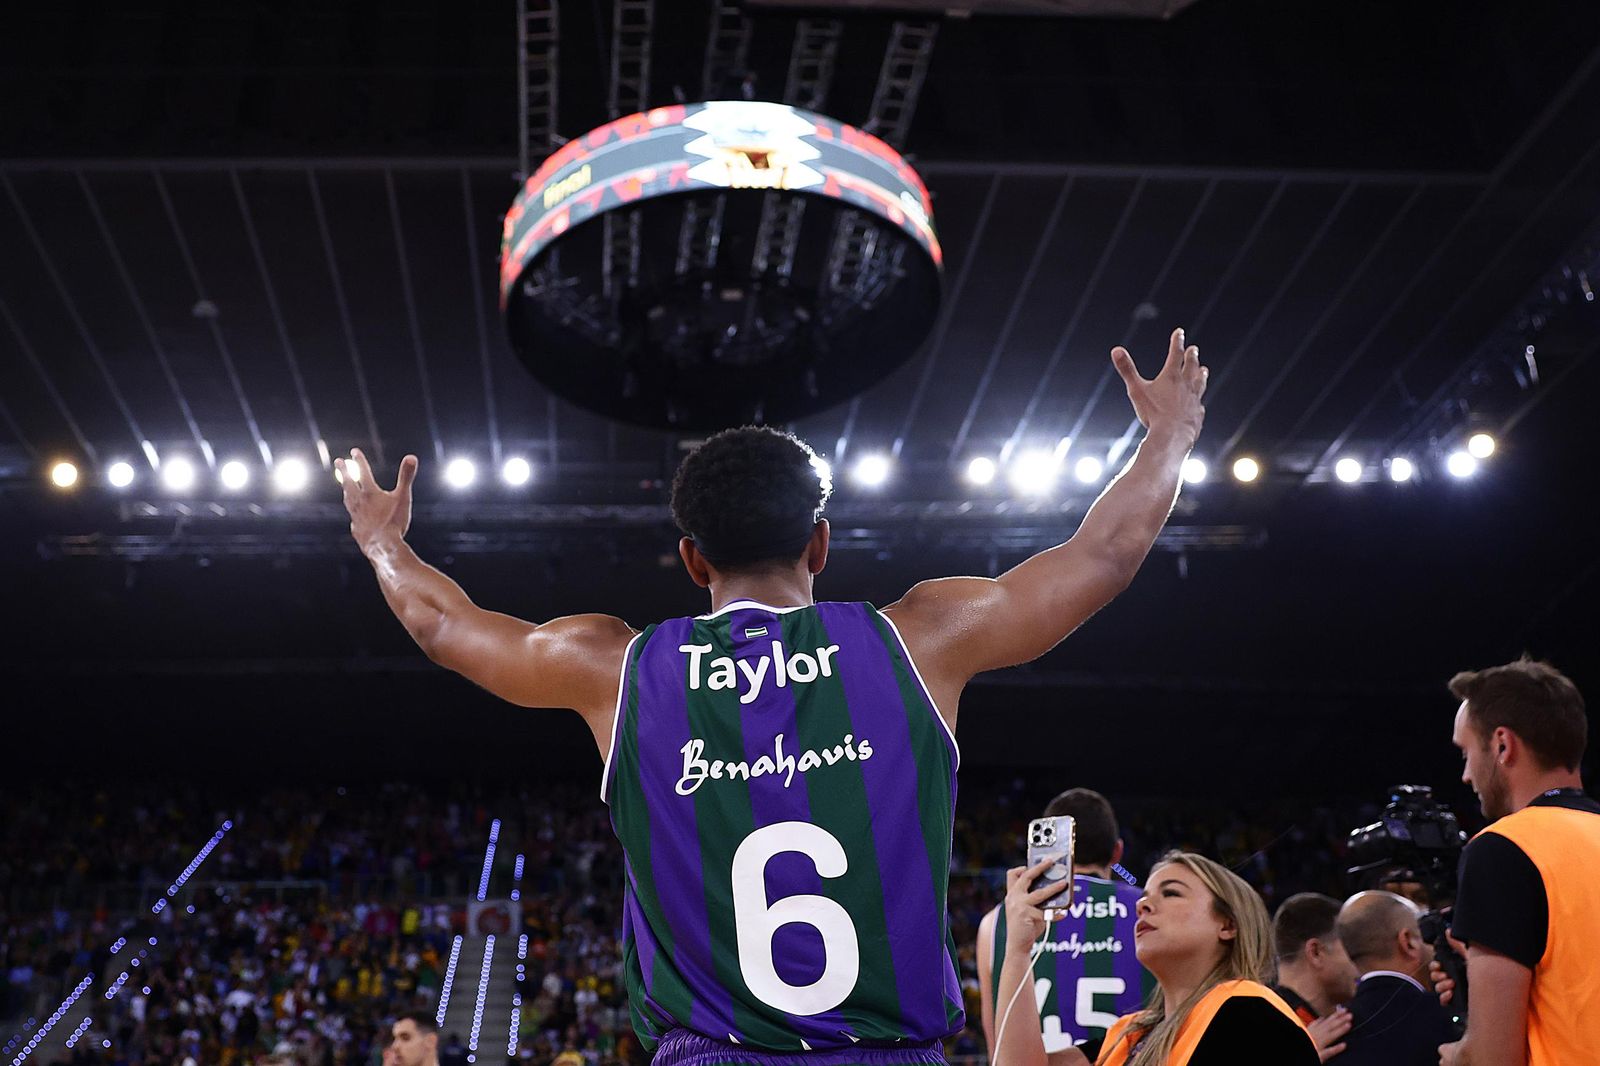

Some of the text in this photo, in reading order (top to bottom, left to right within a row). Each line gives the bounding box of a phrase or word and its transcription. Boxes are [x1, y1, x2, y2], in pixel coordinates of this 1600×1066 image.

[678, 640, 840, 704] Taylor
[675, 733, 874, 796] Benahavis
[731, 821, 860, 1016] 6
[1064, 895, 1128, 919] vish
